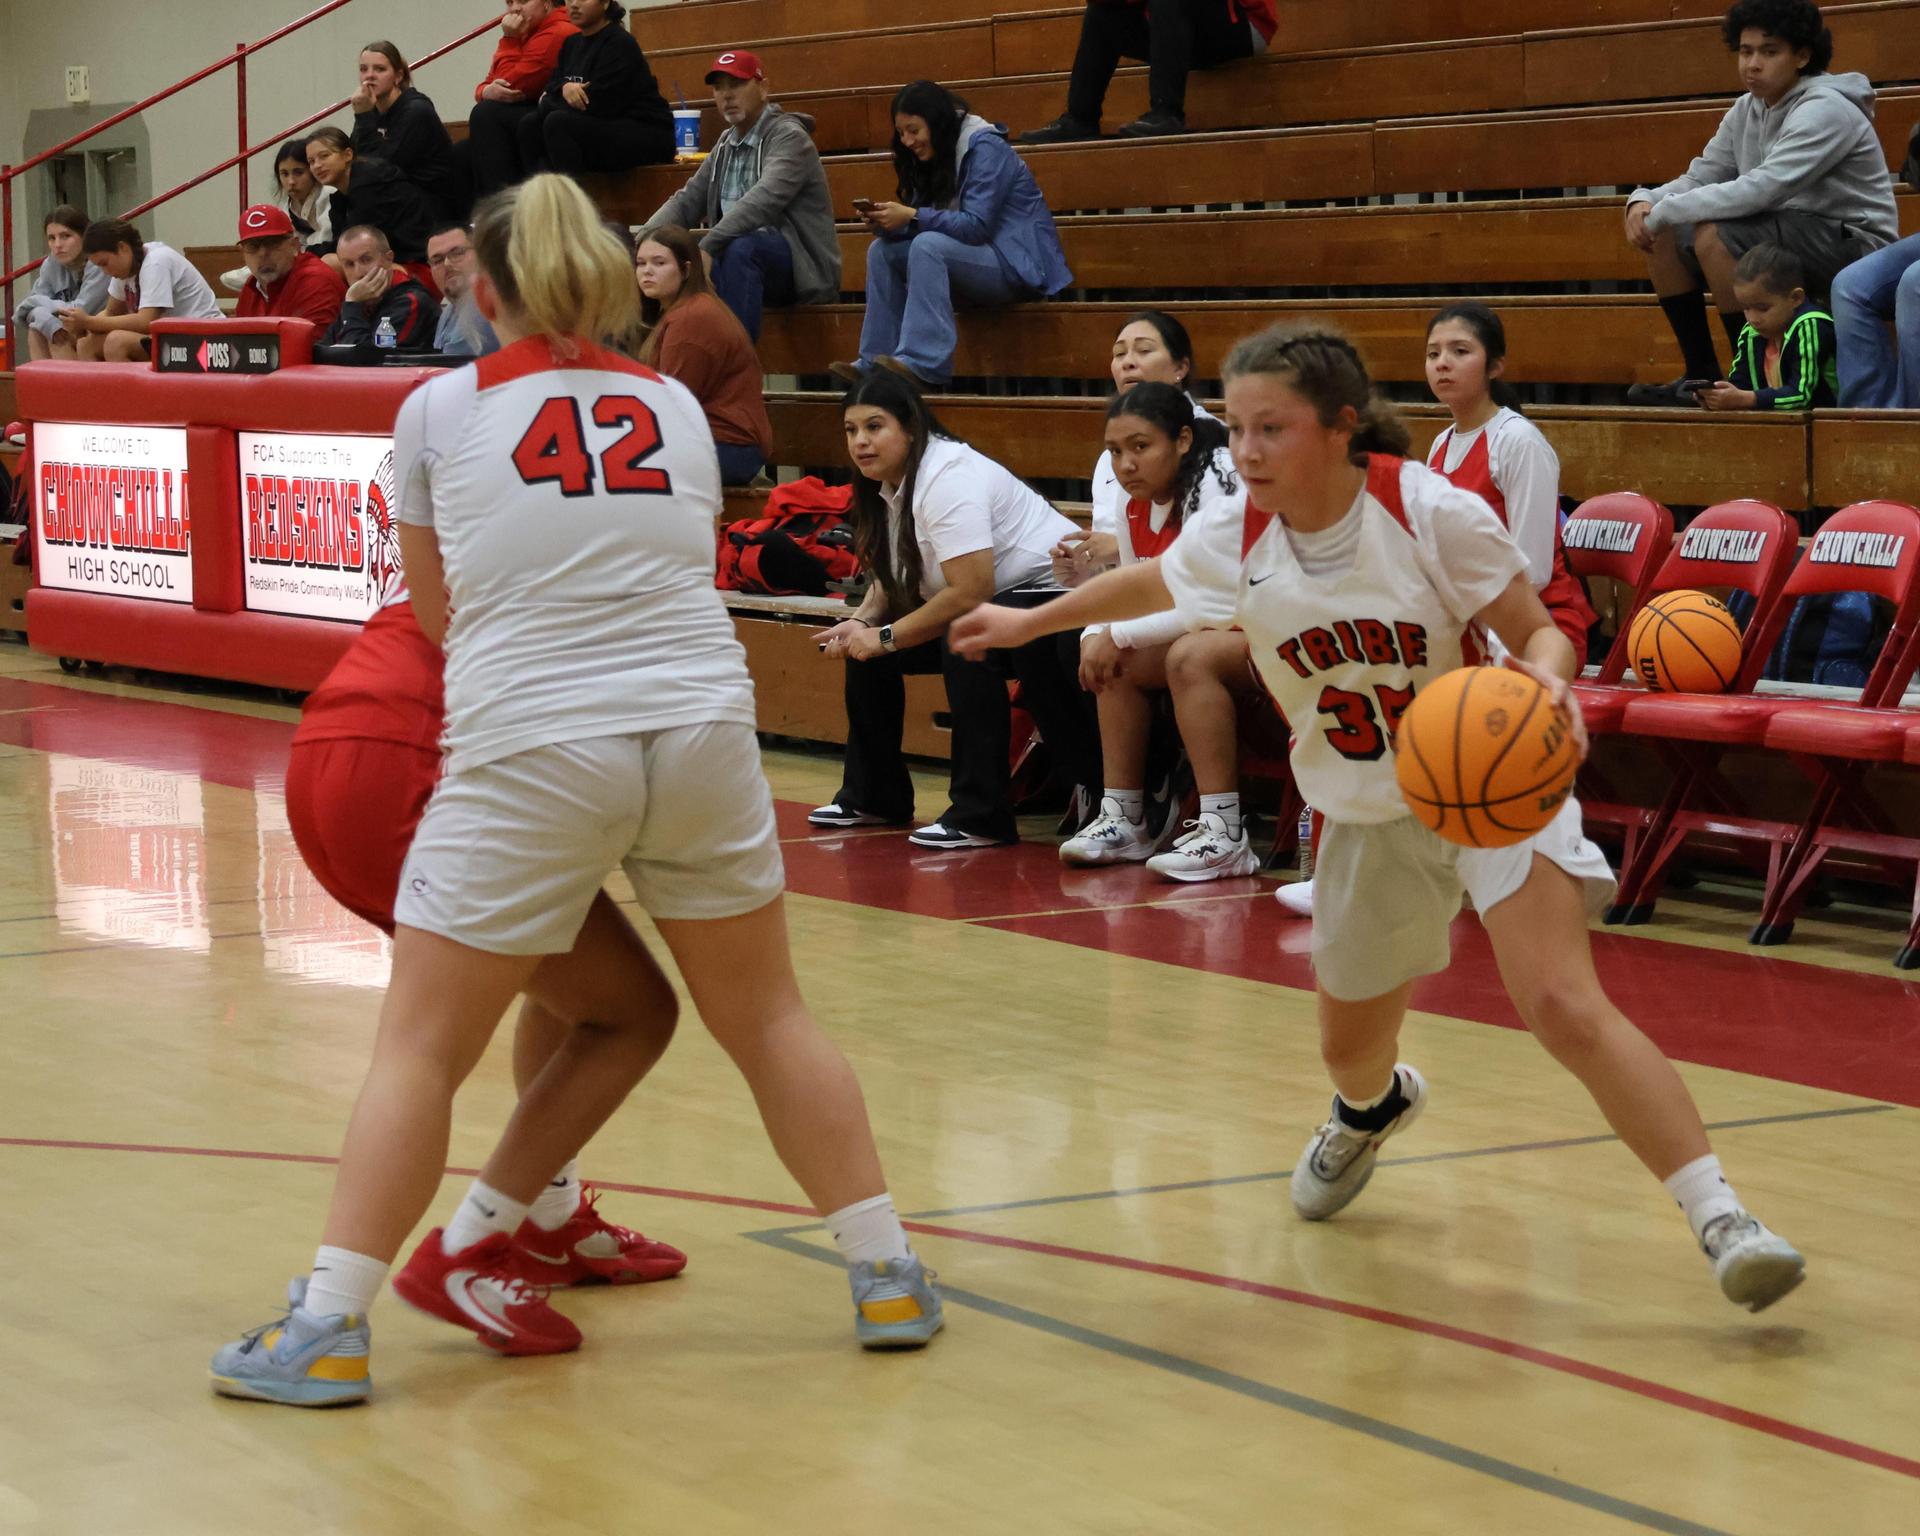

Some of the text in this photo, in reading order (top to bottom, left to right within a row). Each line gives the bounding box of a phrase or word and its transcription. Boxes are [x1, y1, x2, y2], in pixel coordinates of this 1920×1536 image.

[718, 53, 736, 65] C
[246, 210, 268, 228] C
[170, 346, 188, 362] BONUS
[207, 342, 230, 369] POSS
[248, 348, 268, 364] BONUS
[82, 436, 151, 455] WELCOME TO
[253, 444, 352, 468] FCA Supports The
[511, 395, 673, 498] 42
[40, 461, 192, 557] CHOWCHILLA
[246, 473, 364, 573] REDSKINS
[1561, 518, 1643, 553] CHOWCHILLA
[1679, 527, 1768, 563] CHOWCHILLA
[1809, 530, 1905, 568] CHOWCHILLA
[68, 556, 175, 589] HIGH SCHOOL
[250, 575, 365, 602] Redskin Pride Community Wide
[1276, 618, 1428, 679] TRIBE
